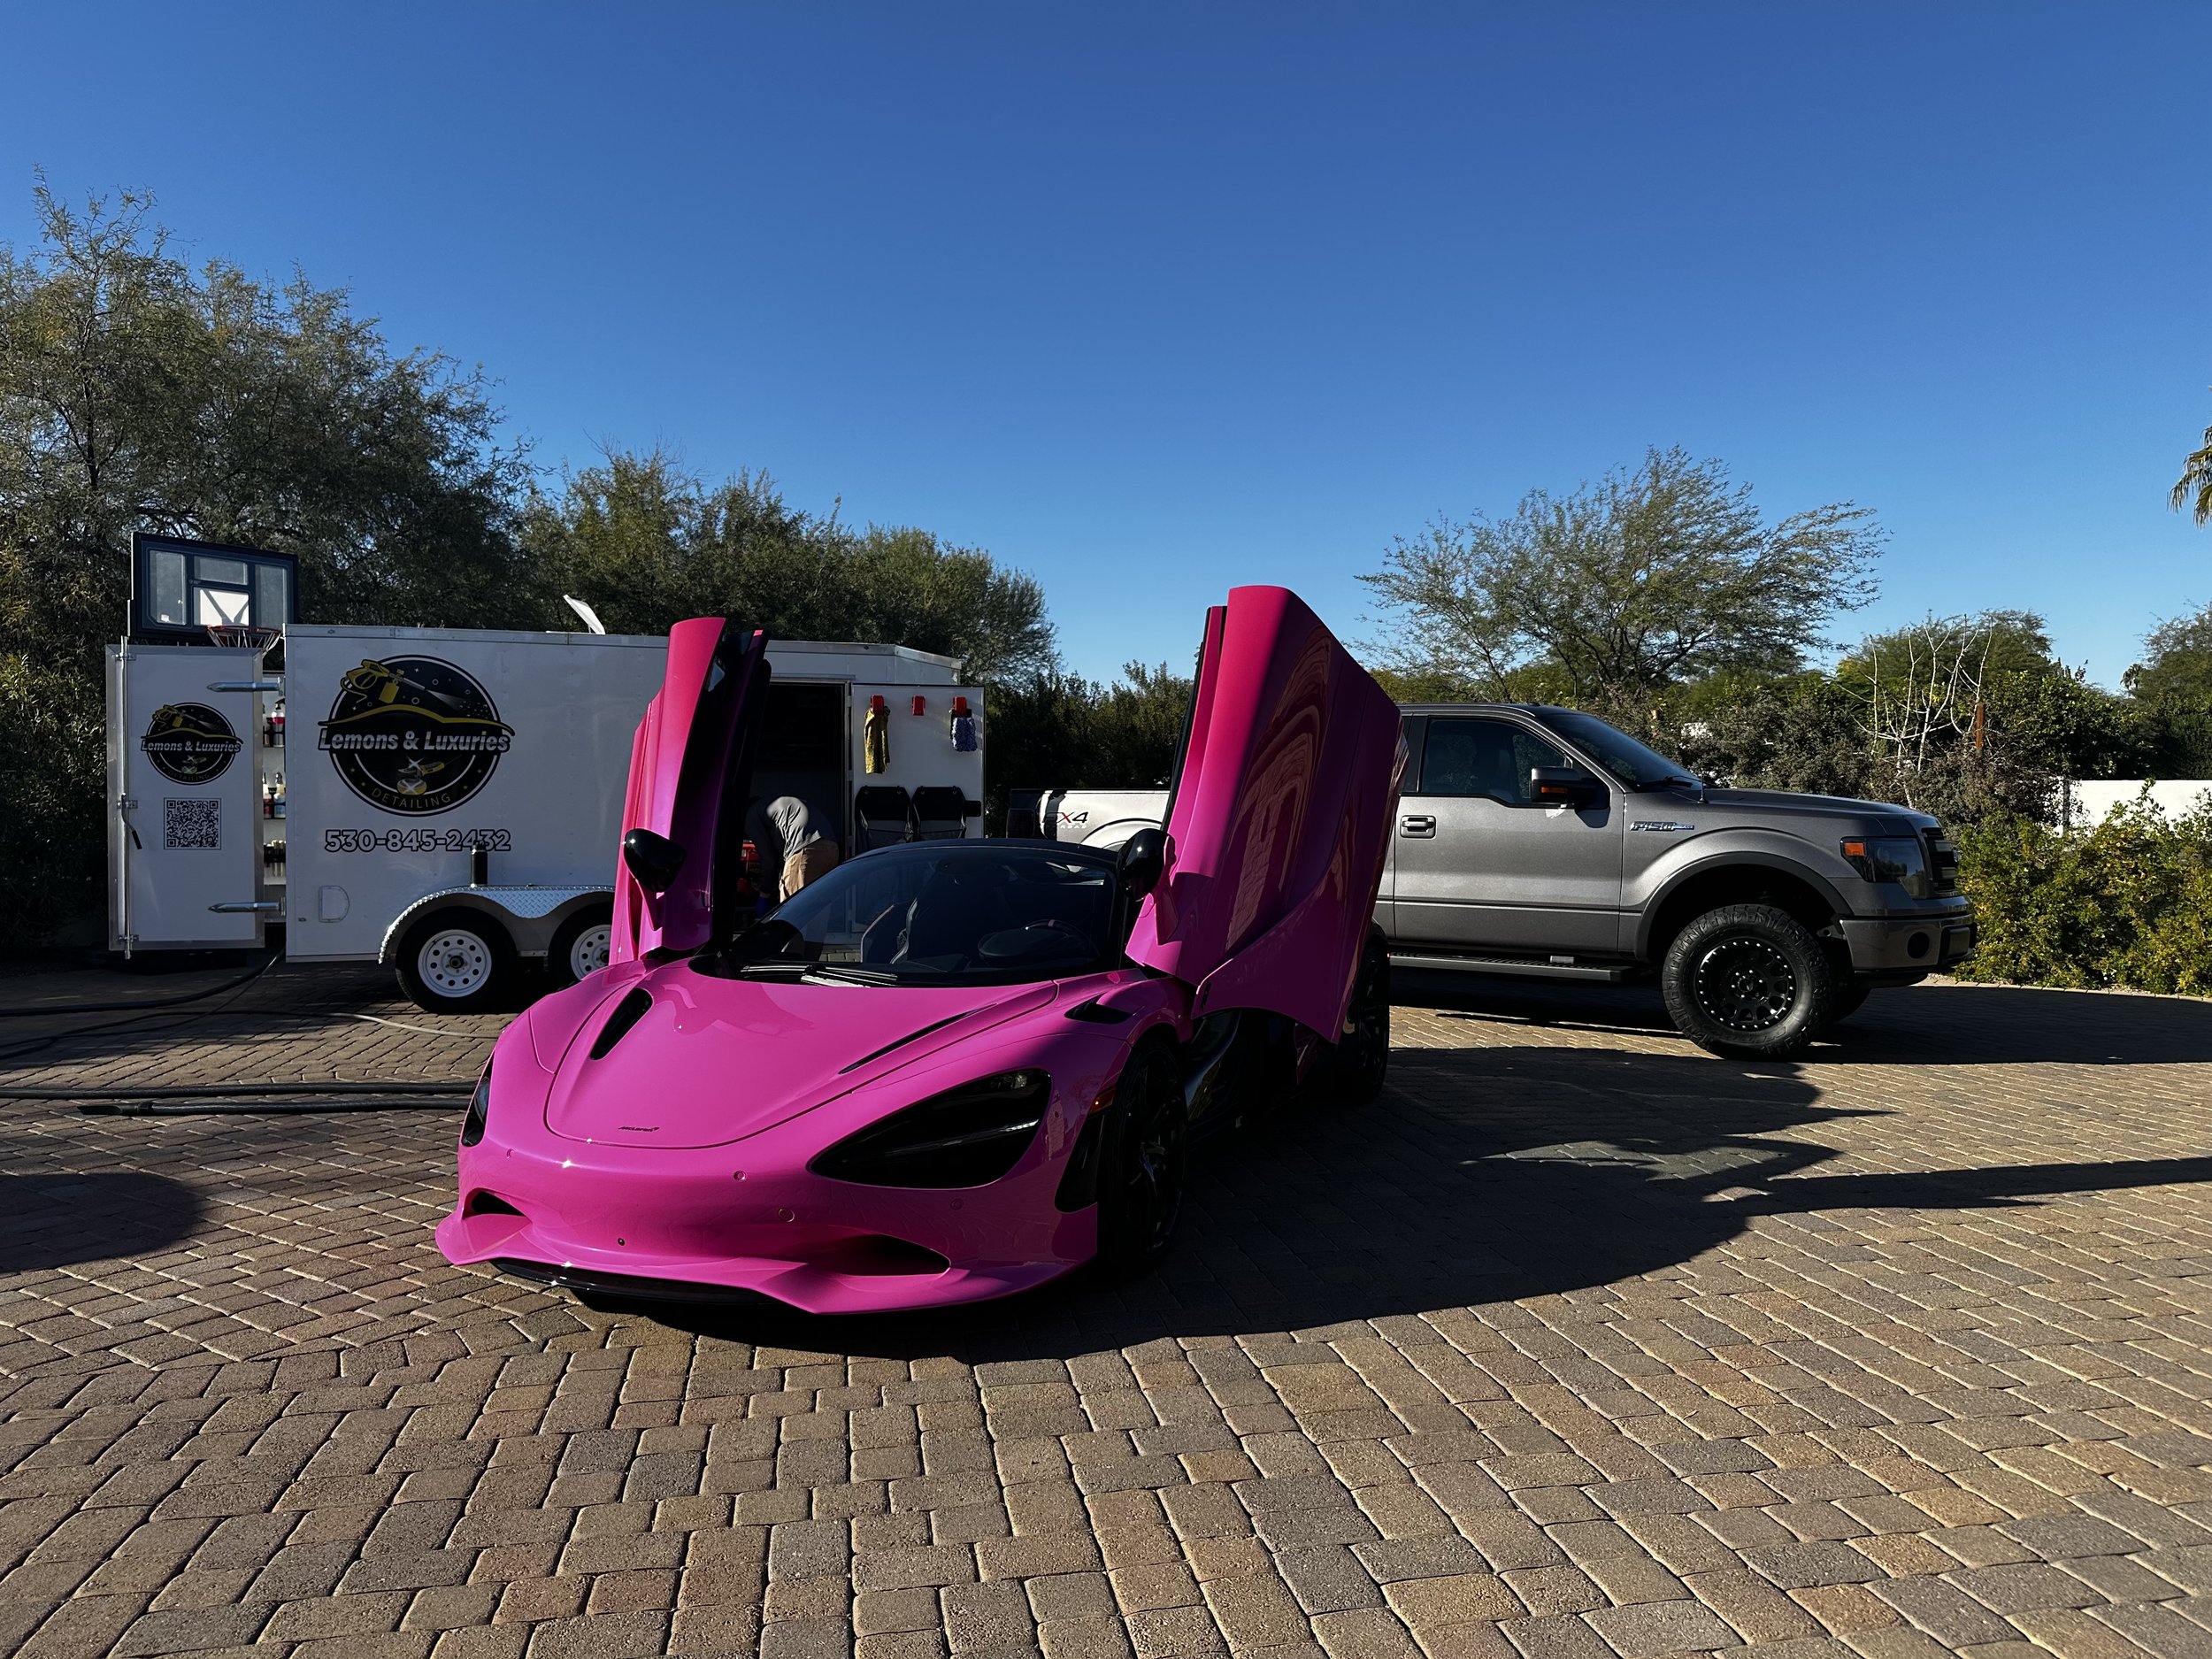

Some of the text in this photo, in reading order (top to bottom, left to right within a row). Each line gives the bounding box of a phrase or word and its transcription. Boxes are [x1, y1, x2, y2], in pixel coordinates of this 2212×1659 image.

[142, 741, 241, 752] Lemons & Luxuries
[319, 730, 509, 751] Lemons & Luxuries
[372, 788, 451, 809] DETAILING
[325, 829, 511, 852] 530-845-2432
